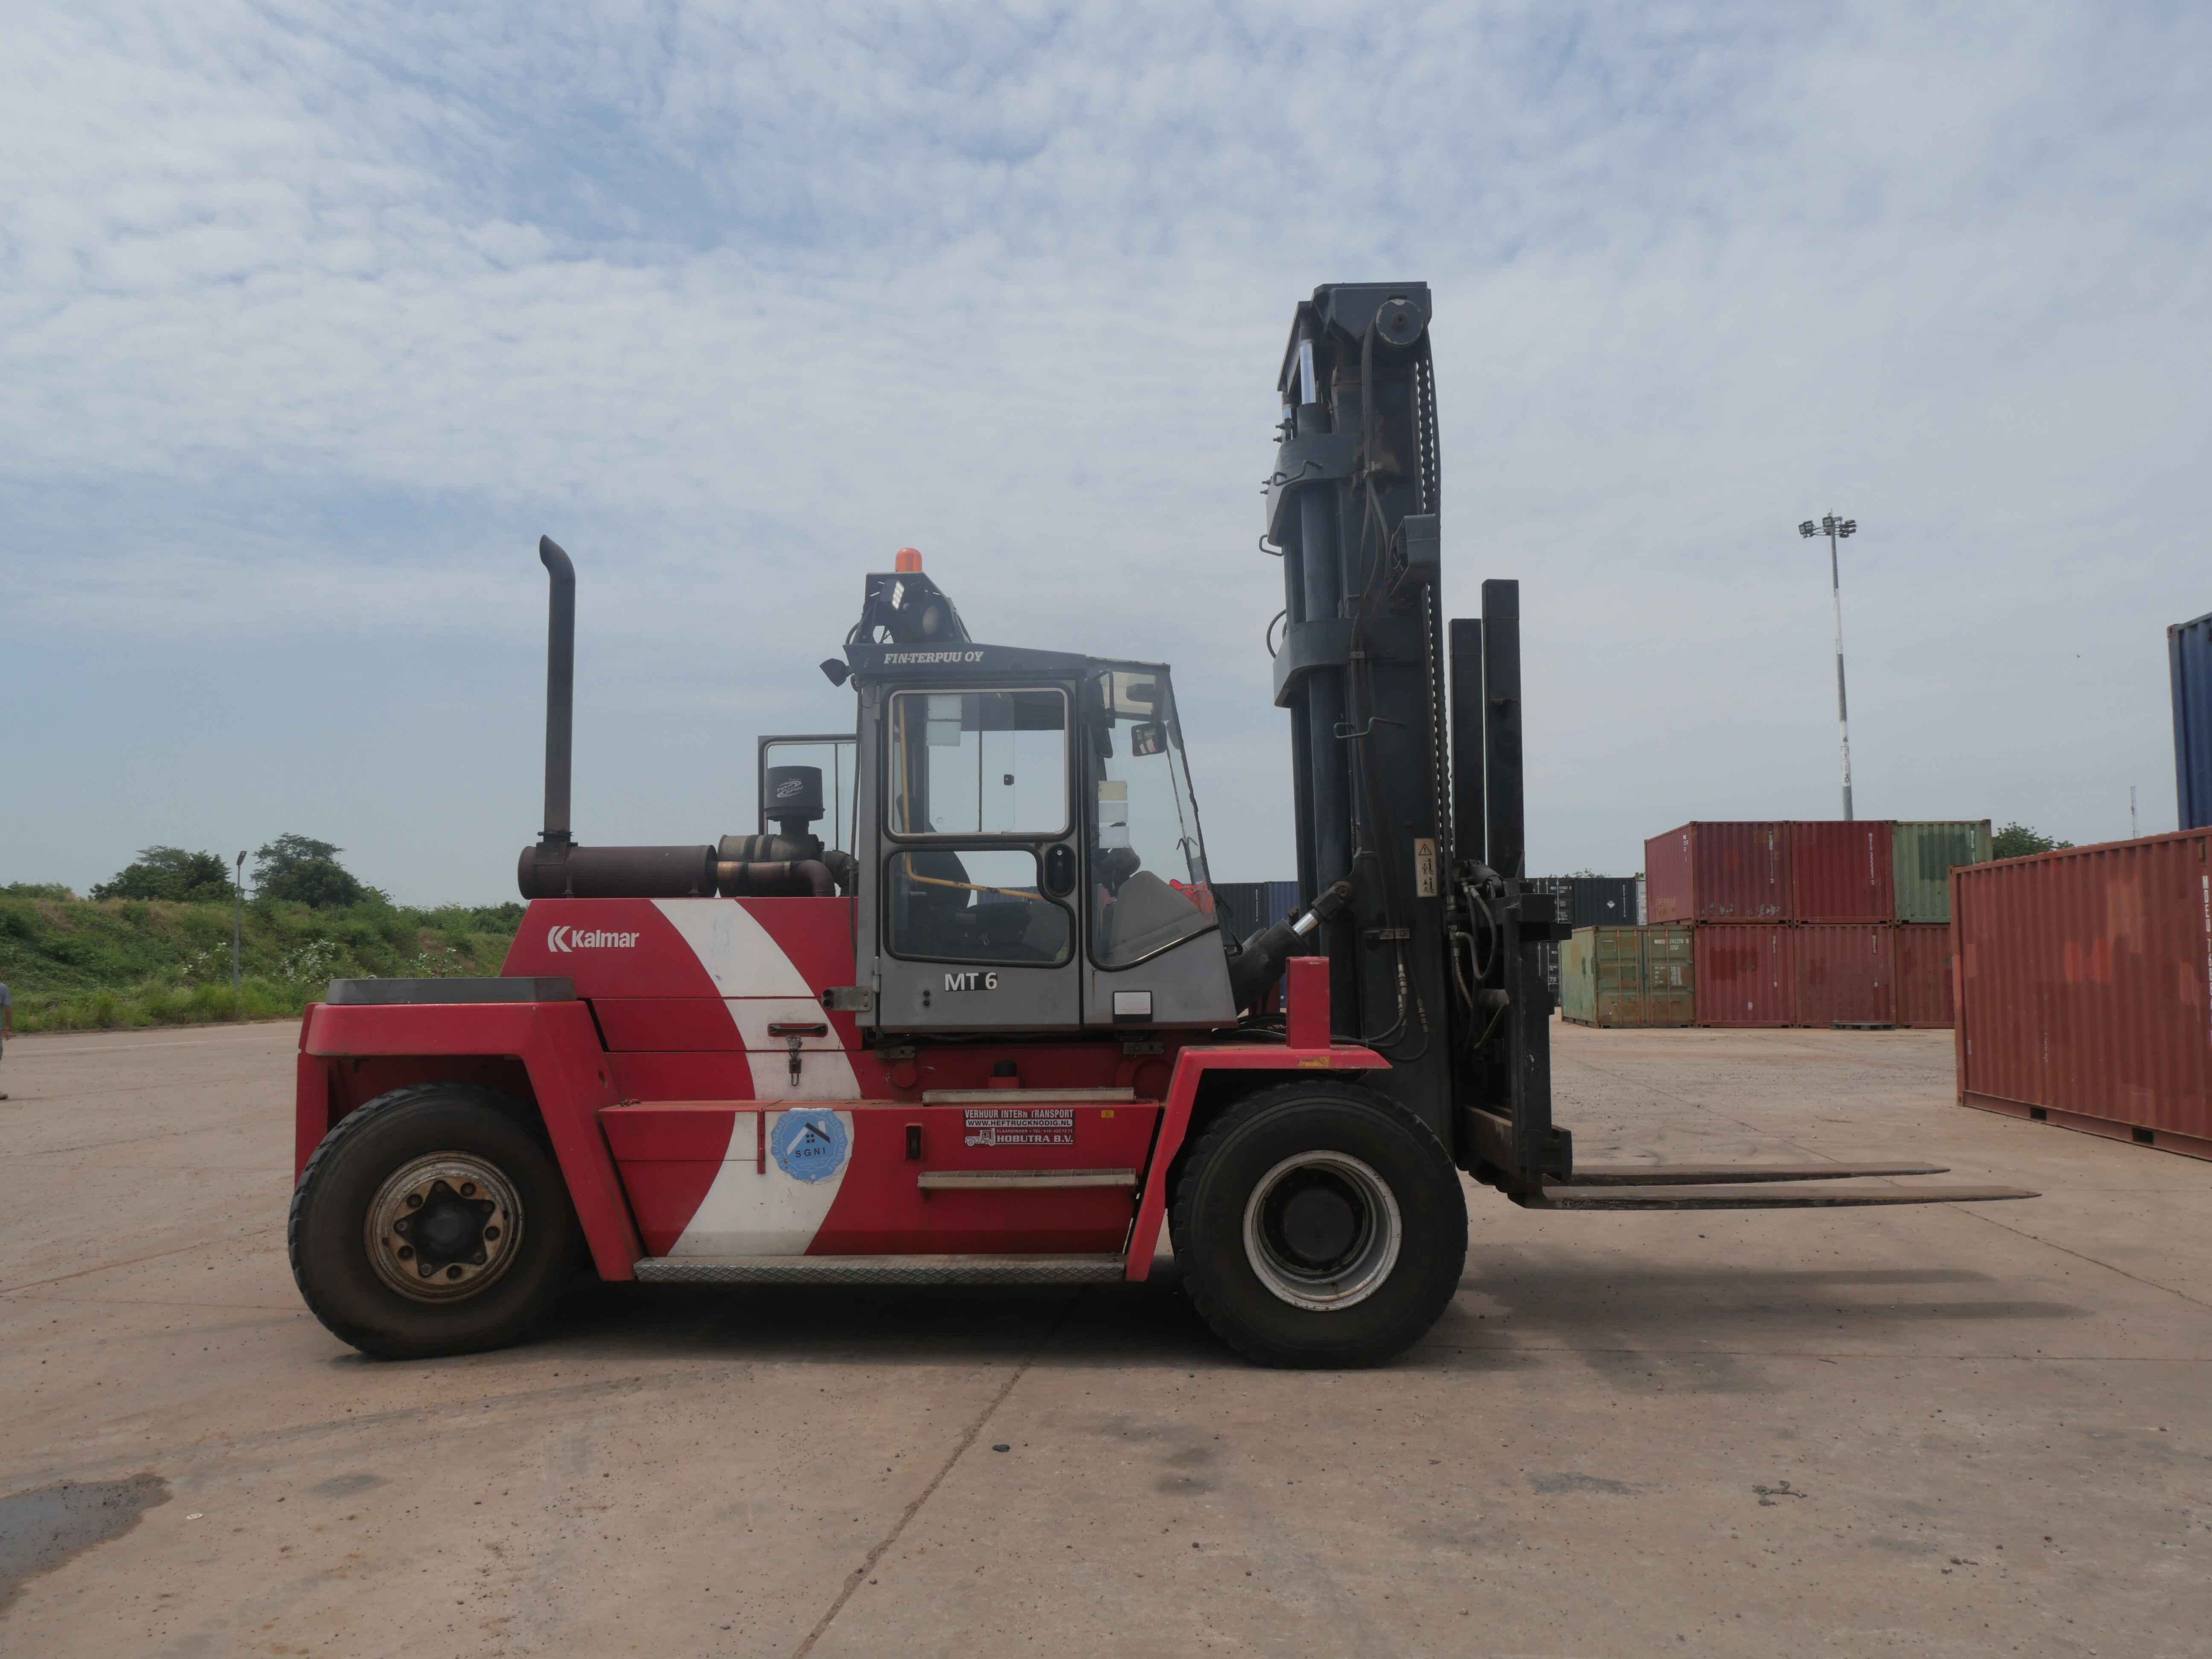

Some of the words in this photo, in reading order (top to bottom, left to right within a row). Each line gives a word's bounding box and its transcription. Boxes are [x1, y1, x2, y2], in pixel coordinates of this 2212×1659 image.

[965, 651, 984, 662] OY
[777, 784, 793, 792] TOP
[785, 786, 803, 794] SPIN
[572, 930, 640, 948] Kalmar
[945, 973, 978, 991] MT
[985, 972, 998, 990] 6
[965, 1109, 998, 1118] VERHUUR
[1001, 1110, 1027, 1118] INTERN
[795, 1147, 826, 1158] SGNI
